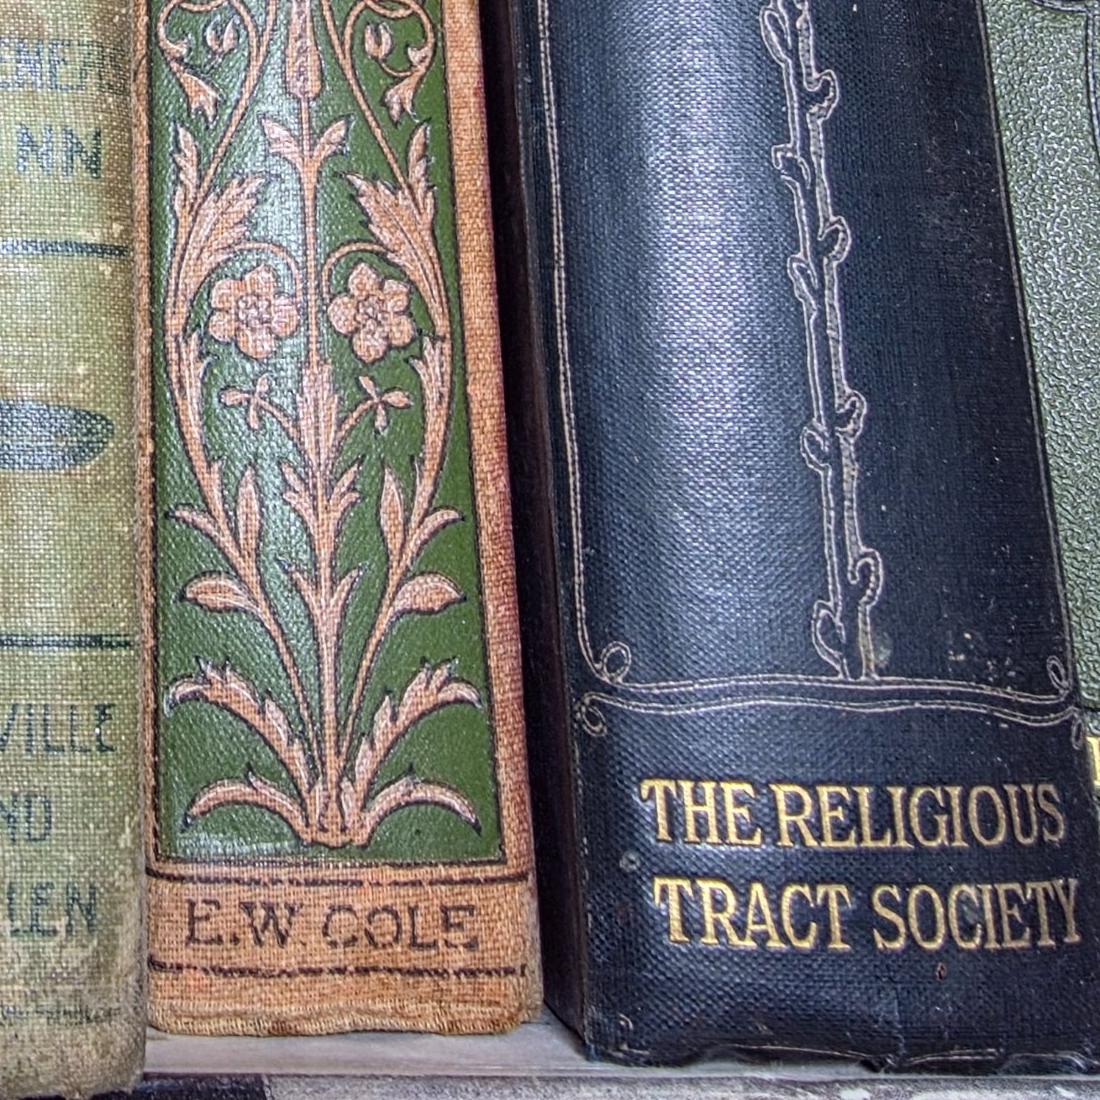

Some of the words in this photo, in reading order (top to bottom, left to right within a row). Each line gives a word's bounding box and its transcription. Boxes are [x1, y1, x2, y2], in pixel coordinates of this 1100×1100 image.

[640, 778, 762, 846] THE
[769, 782, 1066, 848] RELIGIOUS
[321, 902, 480, 953] COLE
[653, 875, 853, 950] TRACT
[871, 878, 1081, 951] SOCIETY
